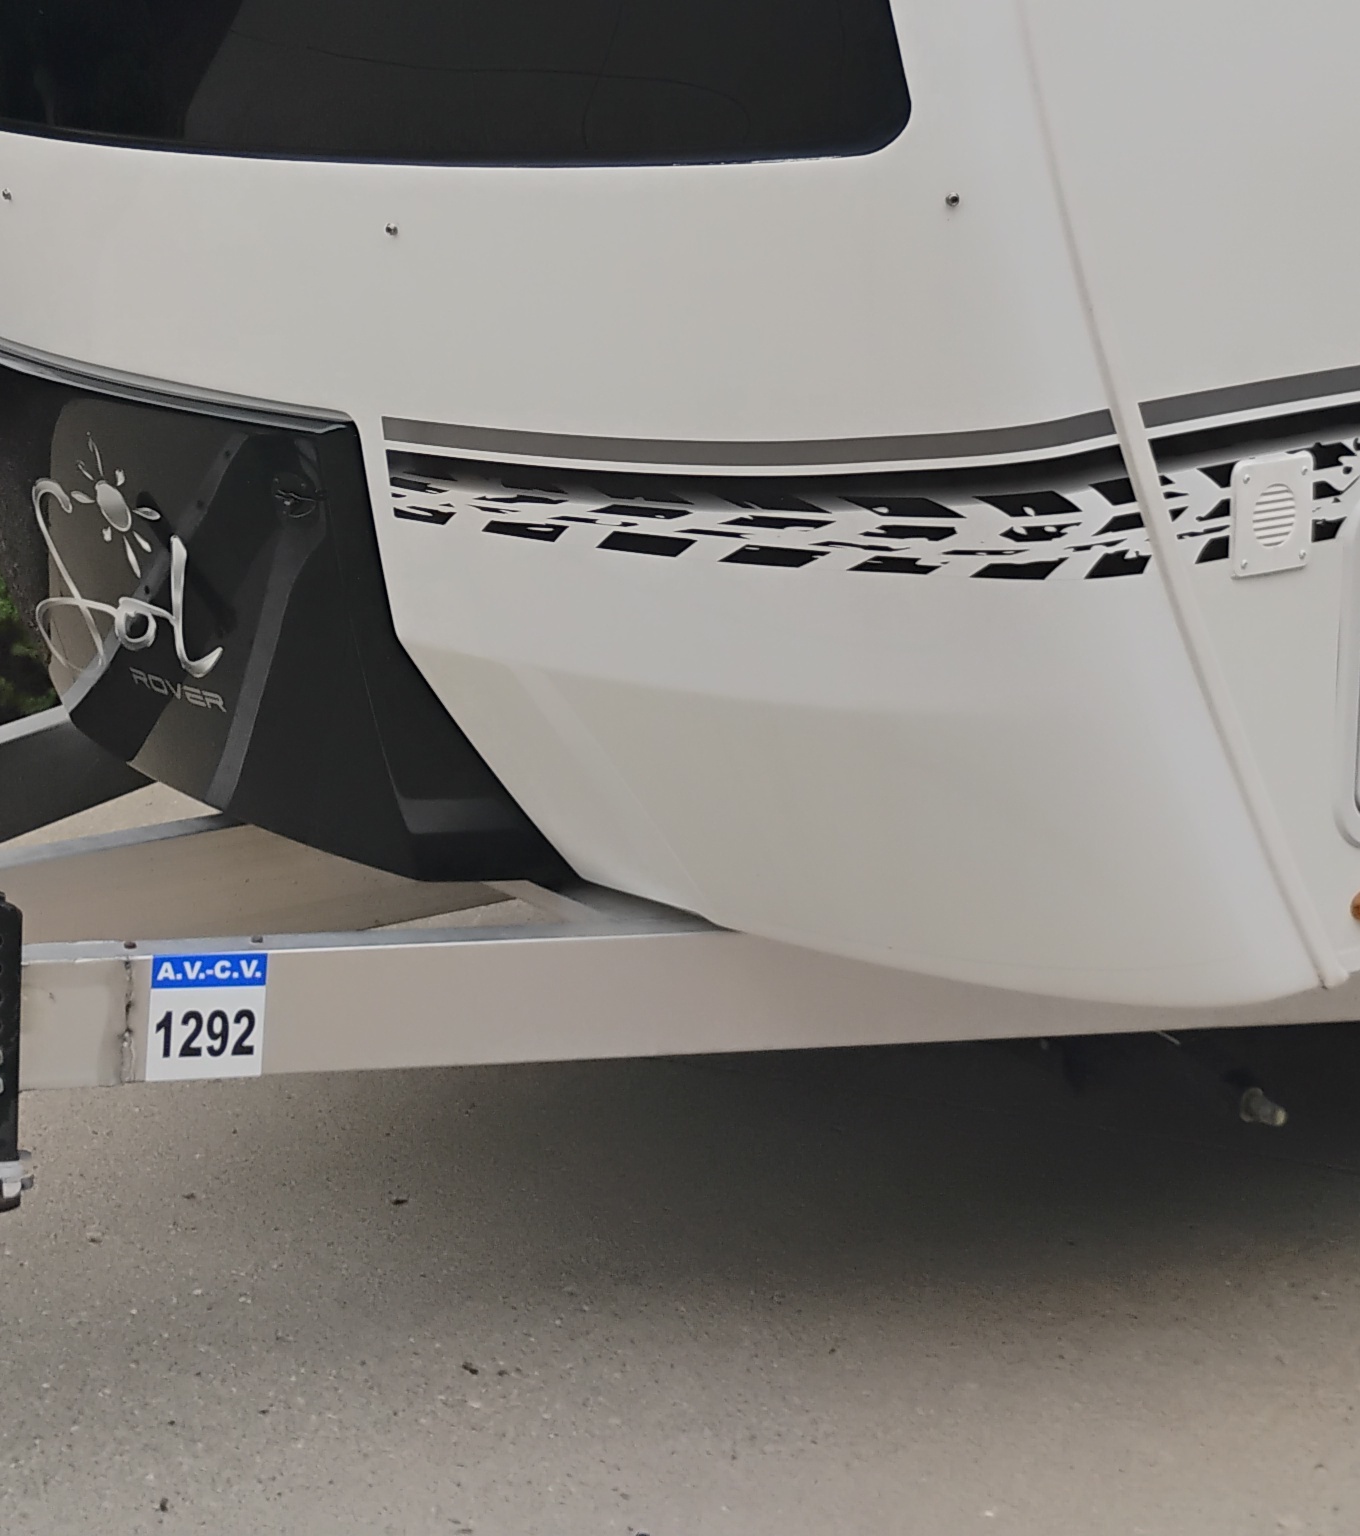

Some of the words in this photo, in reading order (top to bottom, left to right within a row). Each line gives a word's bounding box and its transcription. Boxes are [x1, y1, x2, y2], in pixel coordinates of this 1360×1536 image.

[129, 667, 227, 713] ROVER
[156, 959, 262, 981] A.V.-C.V.
[155, 1008, 256, 1059] 1292
